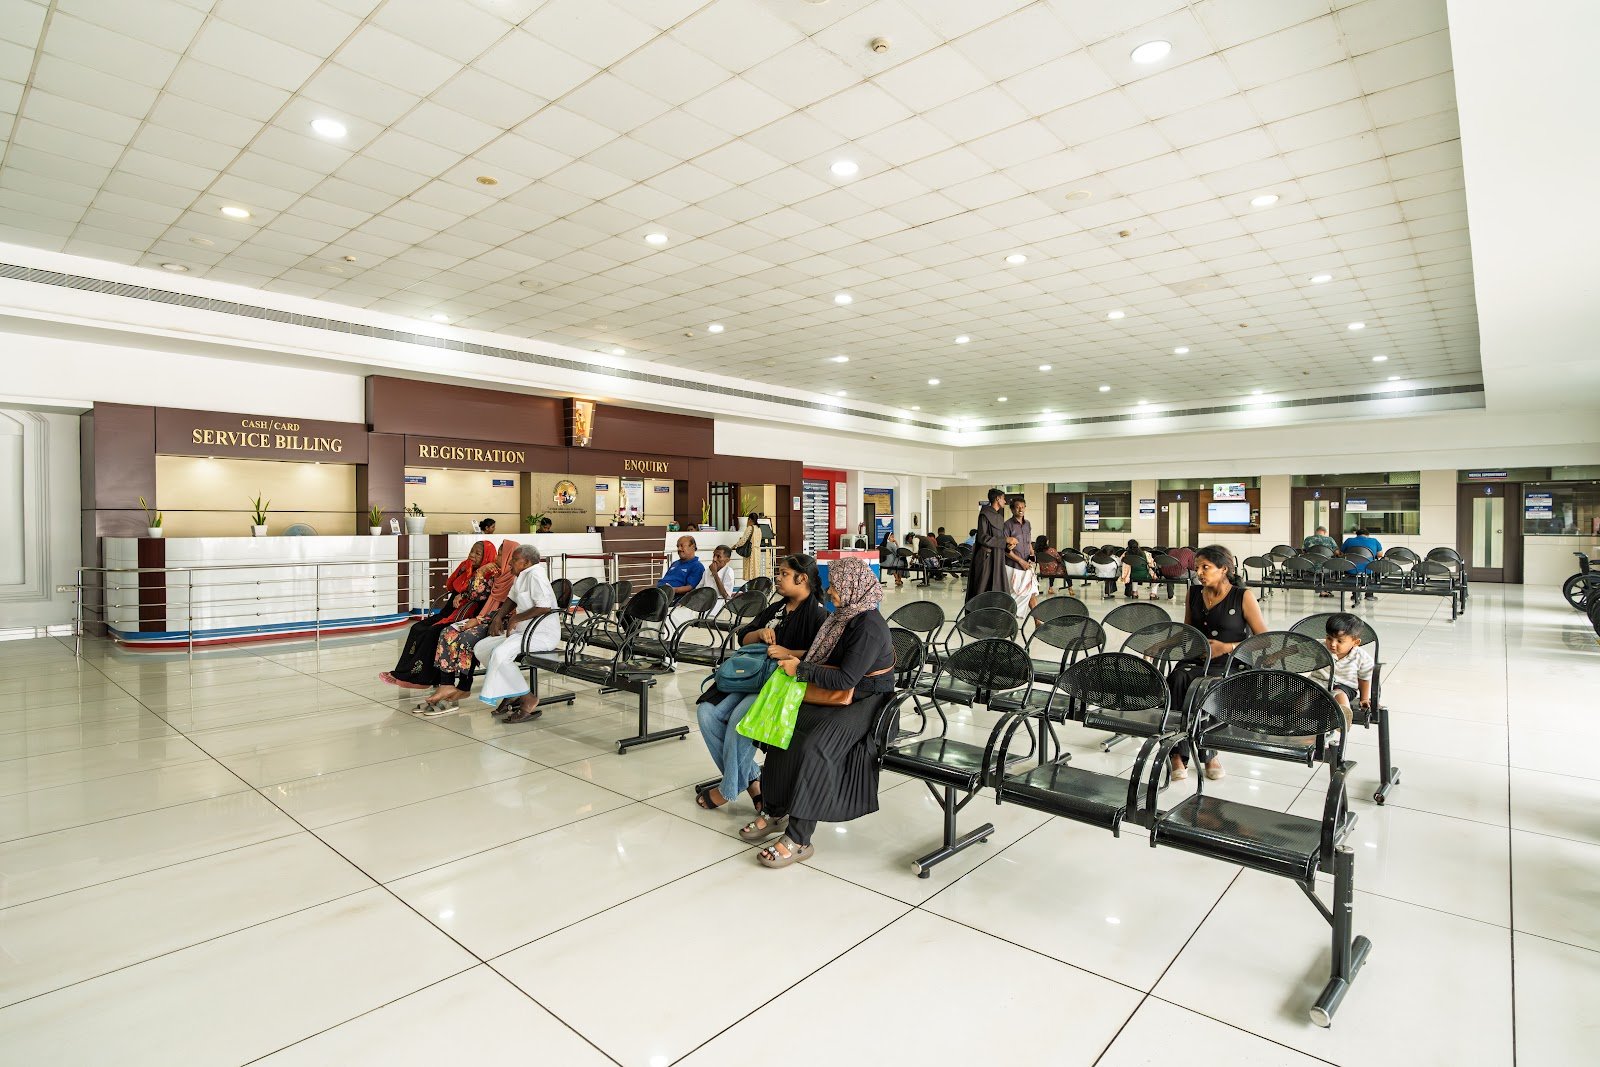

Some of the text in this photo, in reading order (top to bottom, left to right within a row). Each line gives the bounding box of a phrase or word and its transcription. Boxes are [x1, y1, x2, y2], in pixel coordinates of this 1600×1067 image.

[192, 428, 342, 453] SERVICE BILLING
[418, 444, 525, 464] REGISTRATION
[623, 459, 669, 473] ENQUIRY
